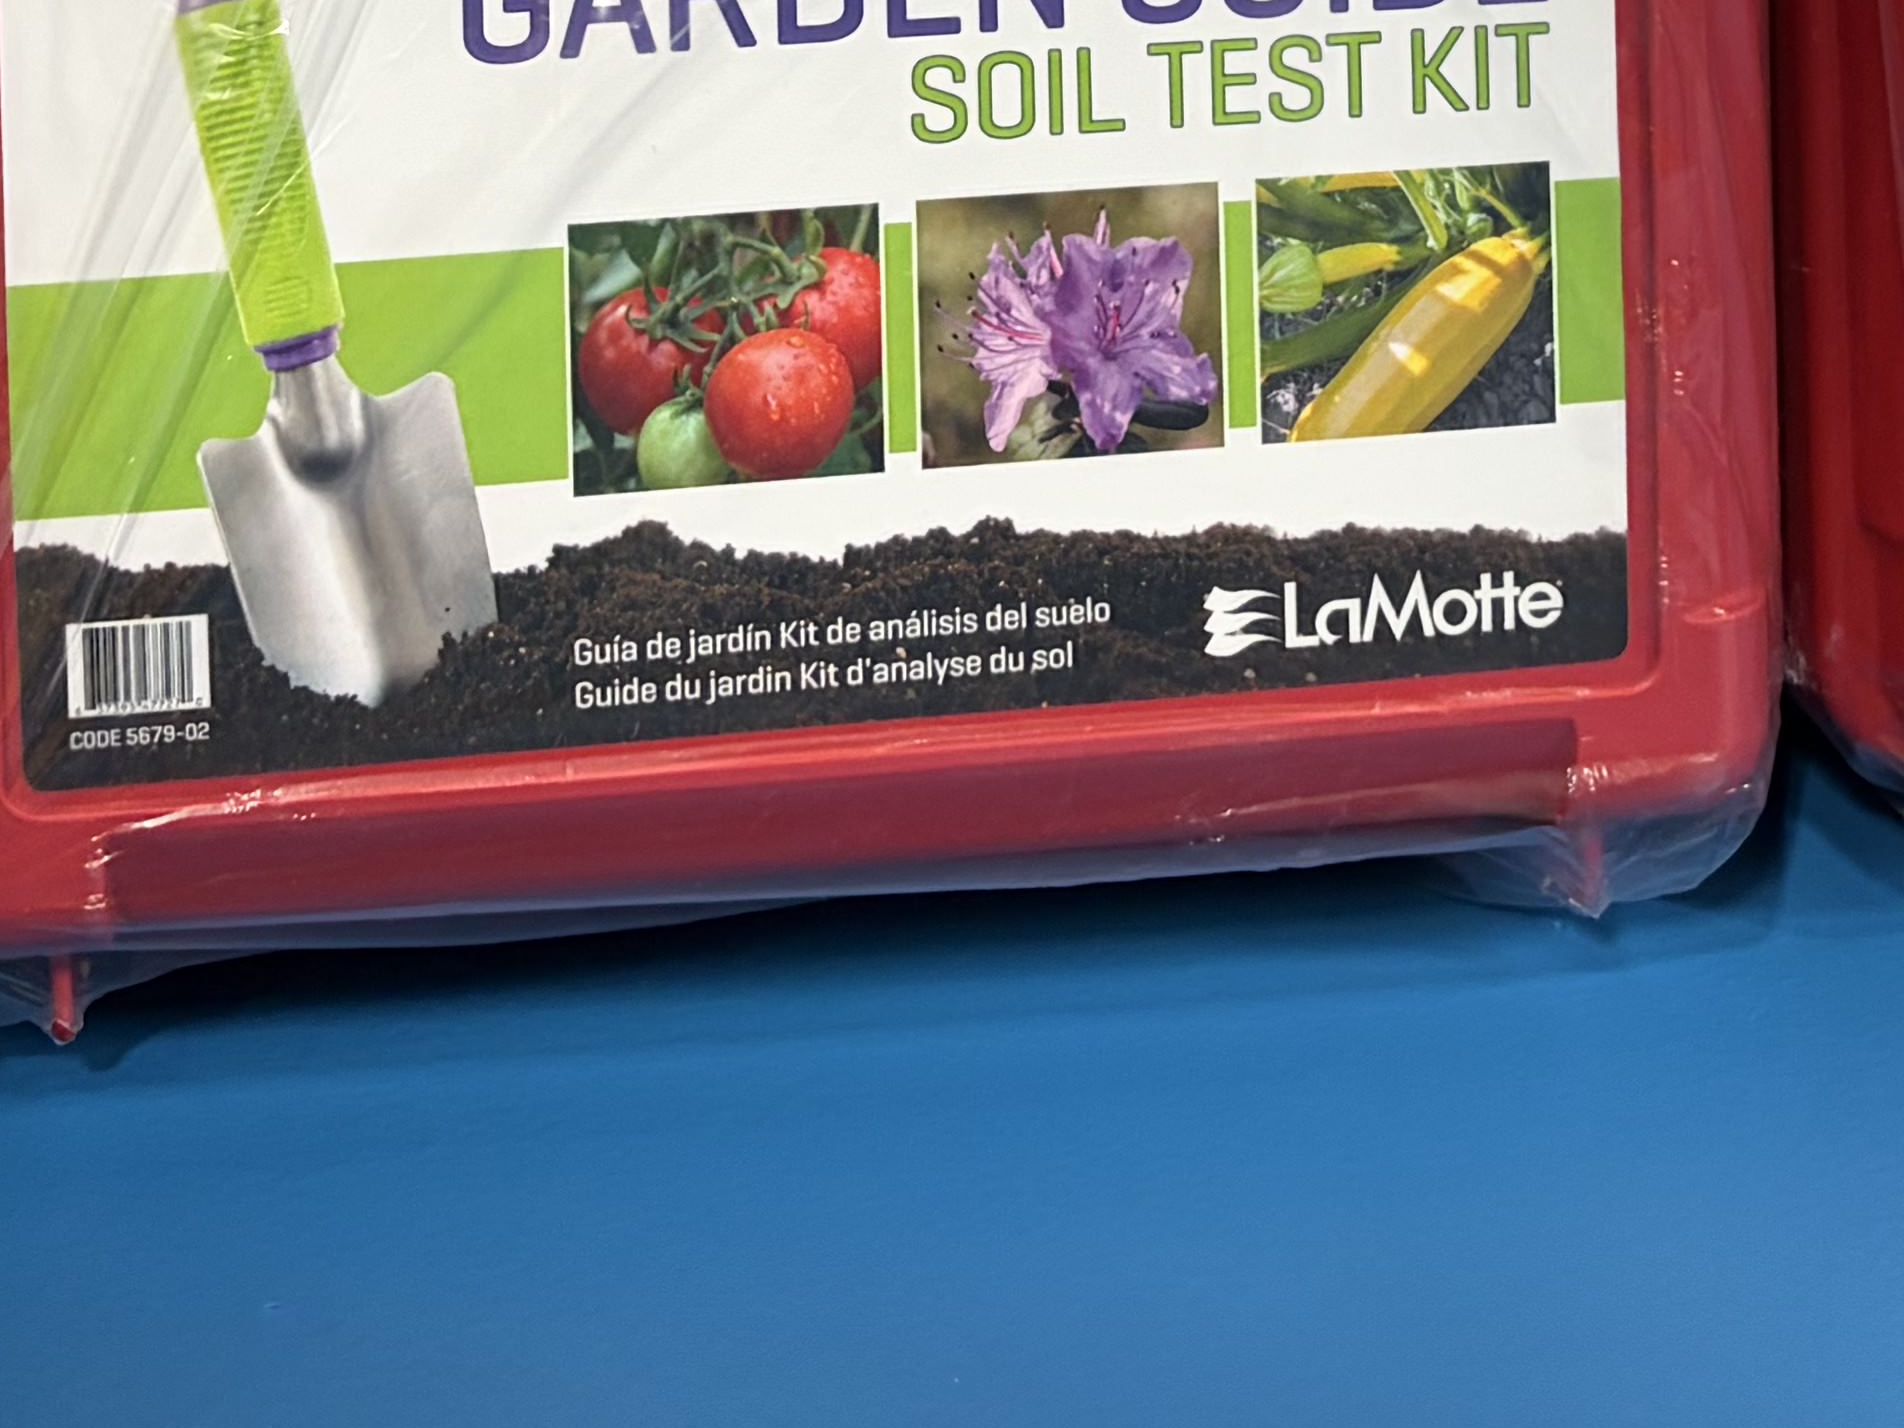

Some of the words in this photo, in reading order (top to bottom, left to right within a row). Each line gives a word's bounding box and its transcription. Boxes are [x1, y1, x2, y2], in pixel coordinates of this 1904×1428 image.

[911, 48, 1126, 145] SOIL
[1150, 31, 1383, 129] TEST
[1411, 22, 1550, 116] KIT
[573, 637, 638, 668] Guía
[646, 633, 680, 662] de
[687, 625, 771, 664] jardín
[780, 620, 819, 650] Kit
[827, 617, 860, 645] de
[868, 609, 978, 641] análisis
[985, 603, 1027, 632] del
[1035, 598, 1111, 629] suelo
[1284, 570, 1564, 648] LaMotte
[575, 677, 657, 710] Guide
[665, 673, 700, 702] du
[707, 666, 791, 705] jardin
[800, 662, 839, 691] Kit
[847, 653, 982, 688] d'analyse
[989, 647, 1024, 674] du
[1031, 641, 1074, 671] sol
[69, 729, 121, 750] CODE
[126, 722, 210, 746] 5679-02
